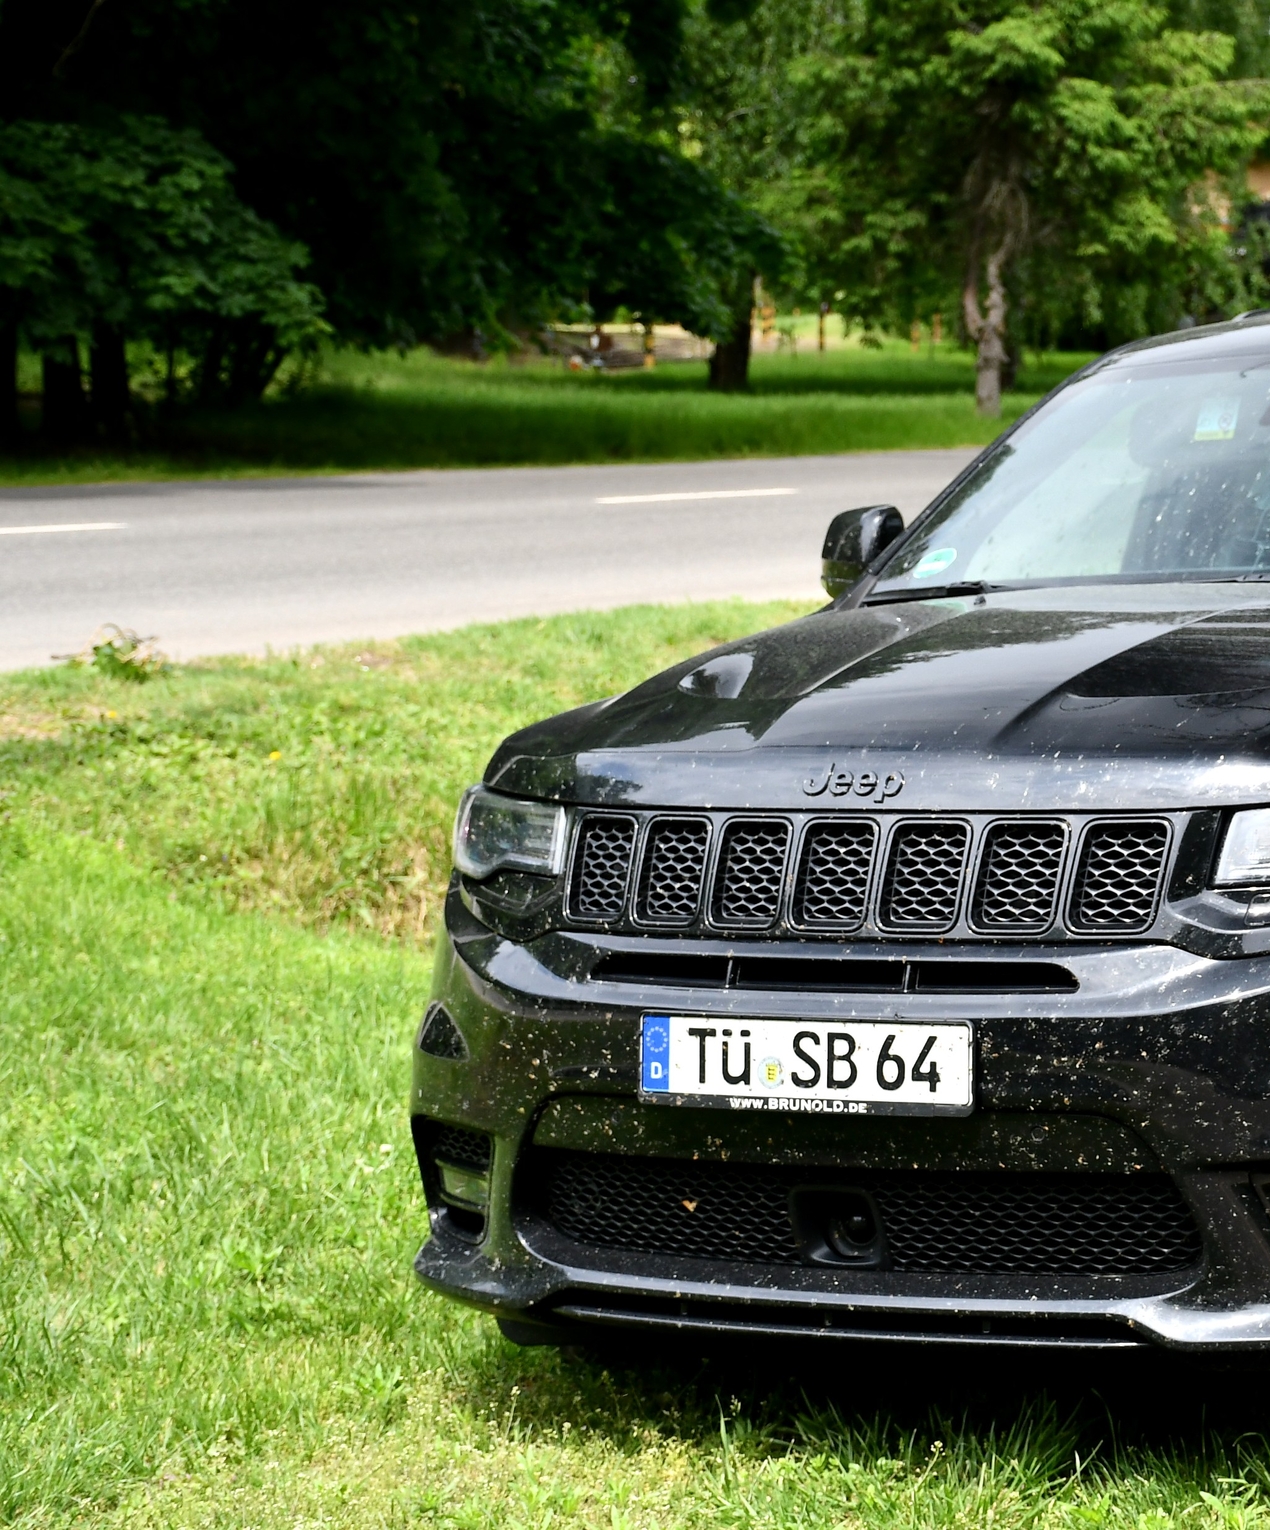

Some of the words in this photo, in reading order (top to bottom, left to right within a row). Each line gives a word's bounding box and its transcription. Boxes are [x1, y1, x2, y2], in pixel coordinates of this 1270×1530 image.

[802, 762, 905, 804] Jeep
[650, 1062, 663, 1079] D
[791, 1030, 858, 1089] SB
[876, 1034, 941, 1093] 64
